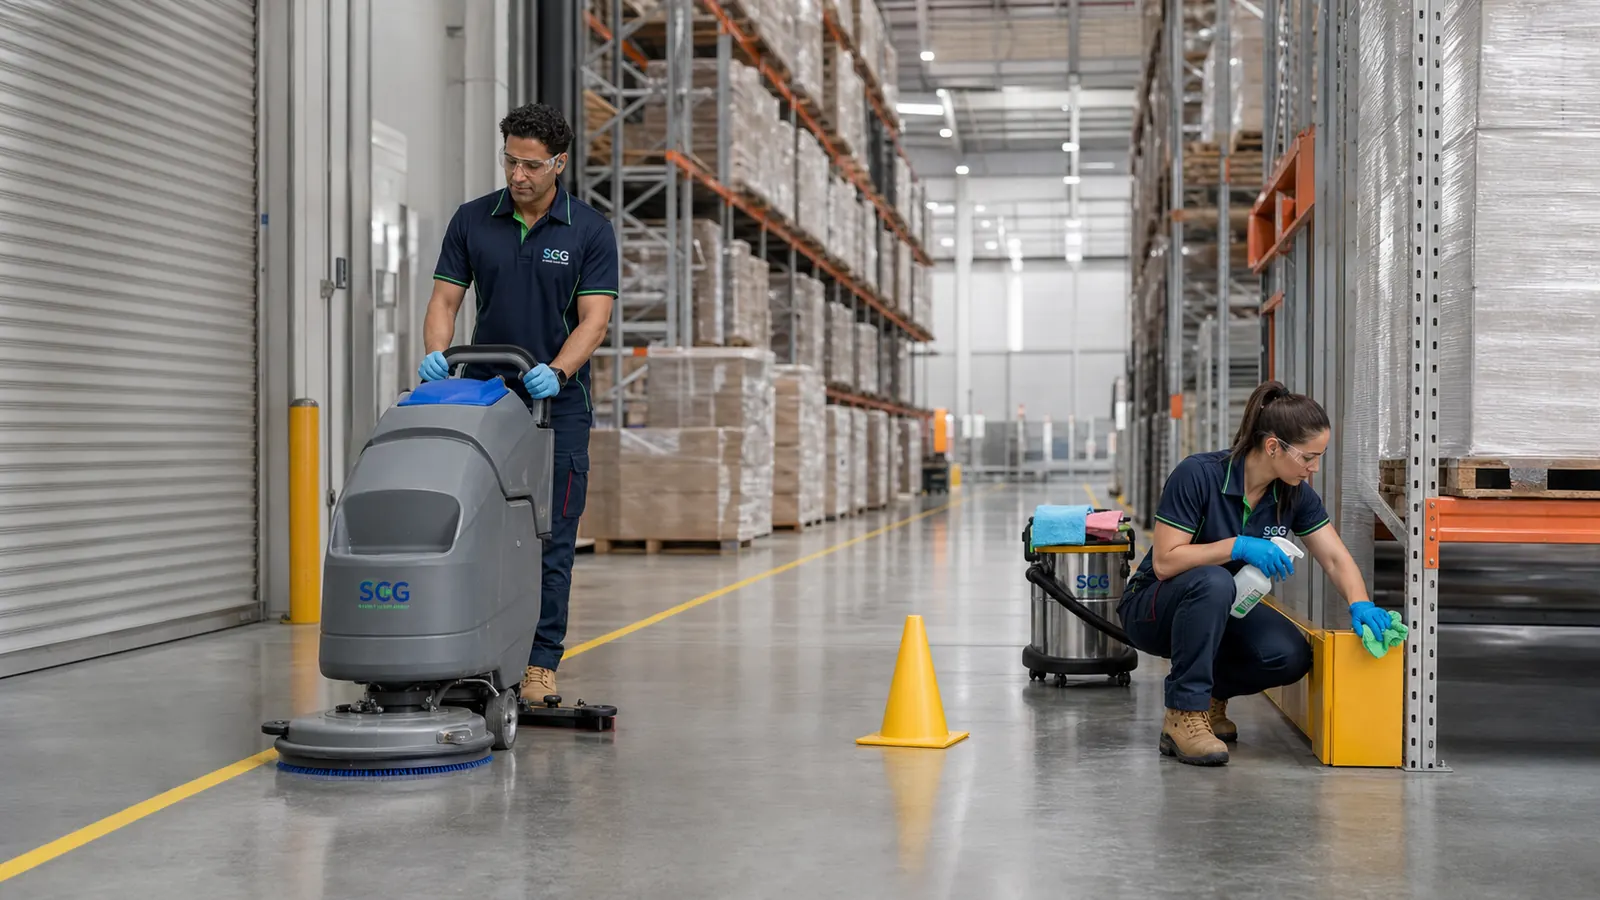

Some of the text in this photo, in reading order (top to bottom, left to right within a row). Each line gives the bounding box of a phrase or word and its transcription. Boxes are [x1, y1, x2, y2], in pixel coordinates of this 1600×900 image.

[543, 248, 569, 261] SCG
[1263, 526, 1286, 536] SCG
[1076, 575, 1109, 589] SCG
[360, 581, 410, 602] SCG
